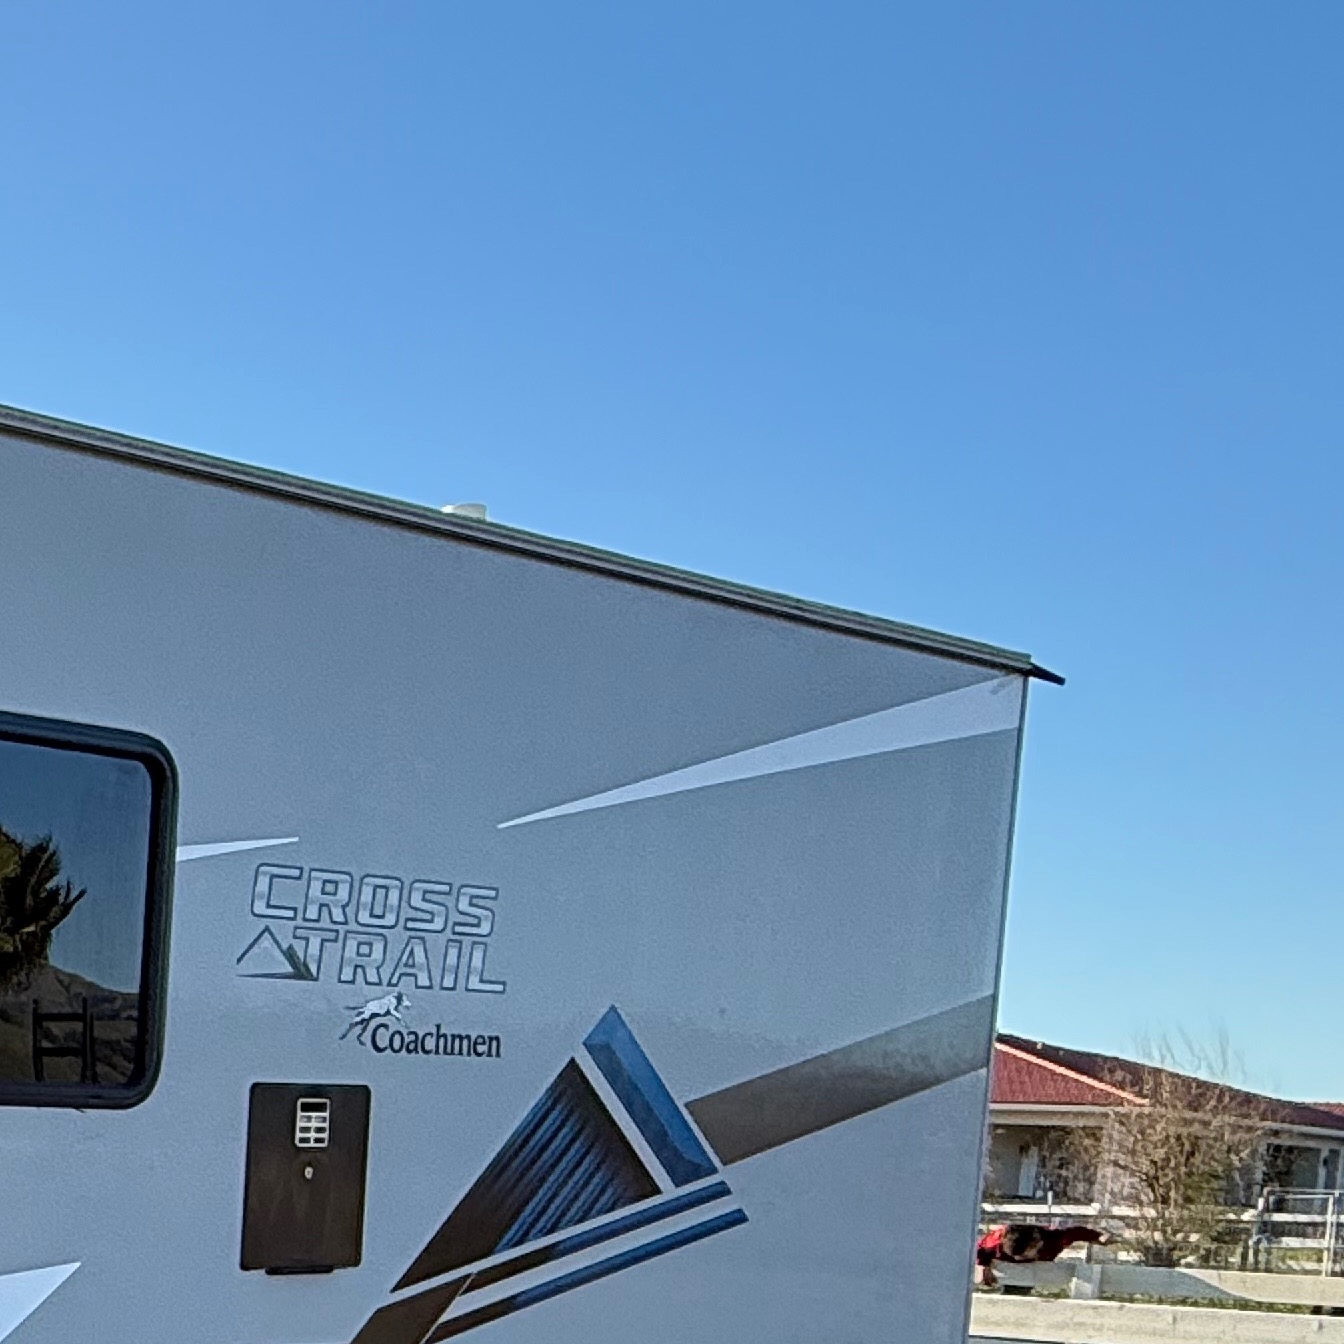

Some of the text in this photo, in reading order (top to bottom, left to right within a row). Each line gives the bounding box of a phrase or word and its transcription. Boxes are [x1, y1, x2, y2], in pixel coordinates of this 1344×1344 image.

[251, 863, 499, 937] CROSS
[292, 926, 507, 994] TRAIL
[370, 1022, 501, 1059] Coachmen
